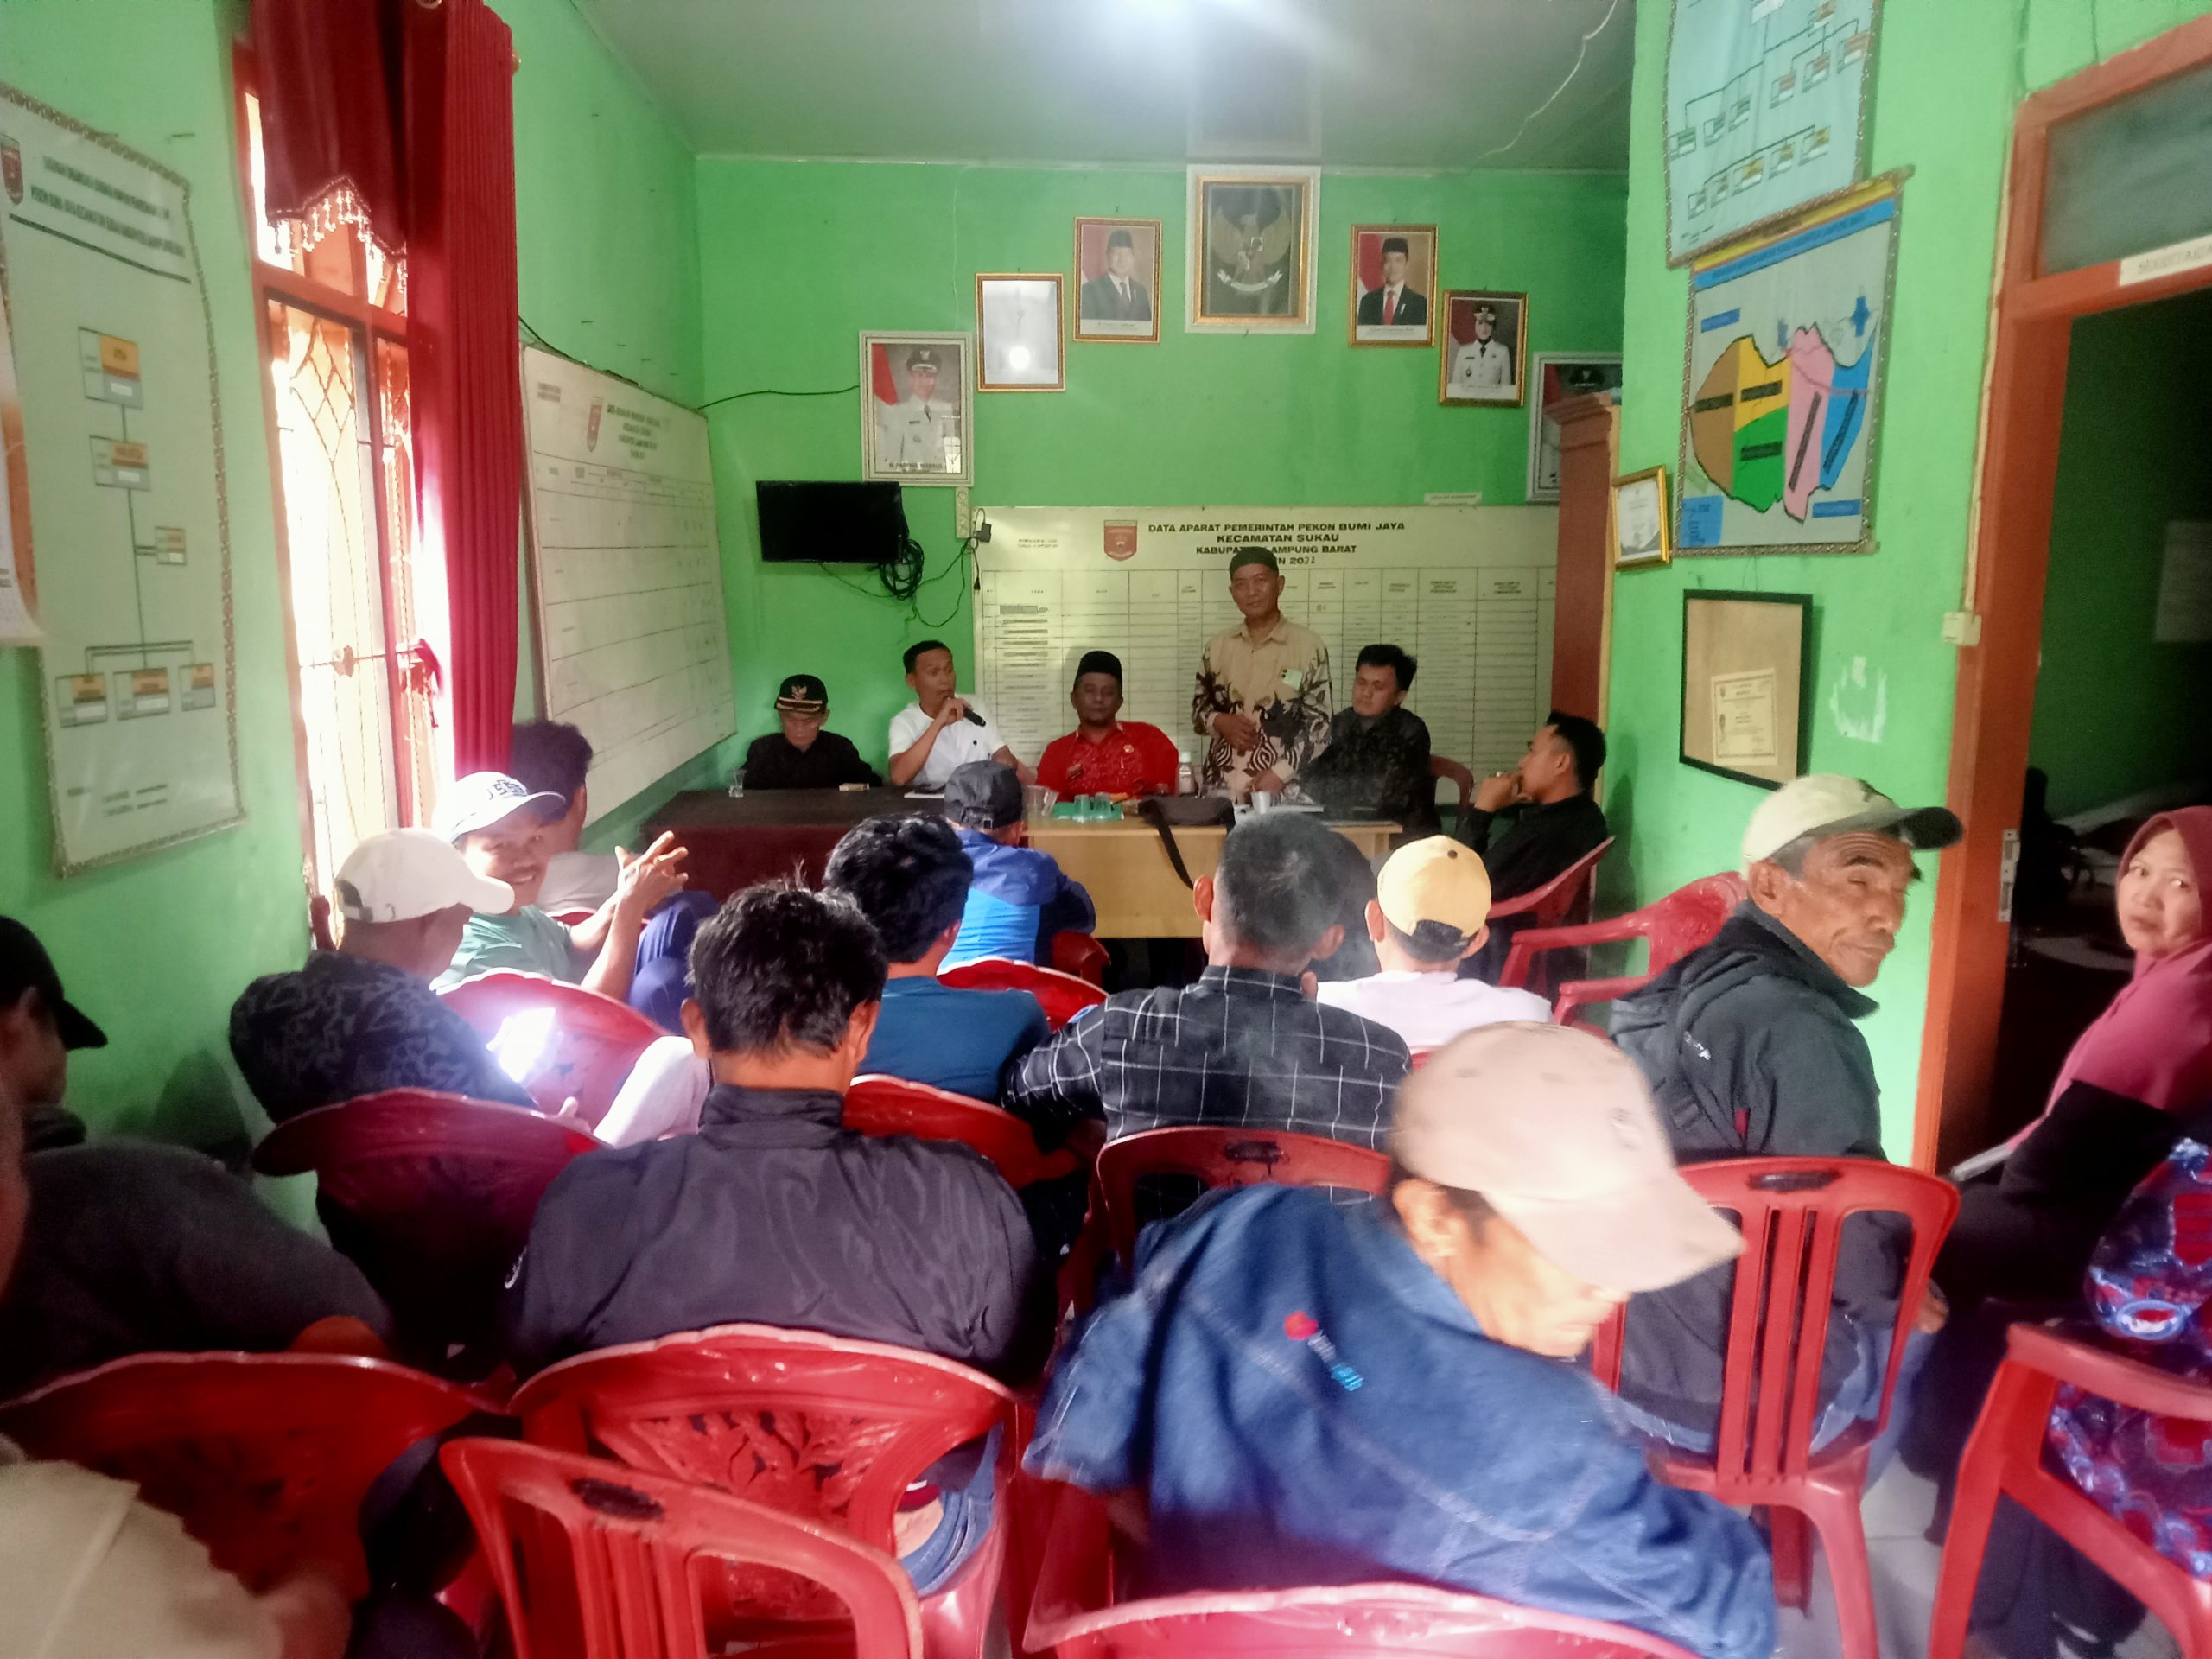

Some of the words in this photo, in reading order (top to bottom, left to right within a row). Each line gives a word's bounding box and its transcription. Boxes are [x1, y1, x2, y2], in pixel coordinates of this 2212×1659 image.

[1224, 523, 1294, 531] PEMERINTAH
[1338, 522, 1371, 531] BUMI
[1217, 534, 1293, 543] KECAMATAN
